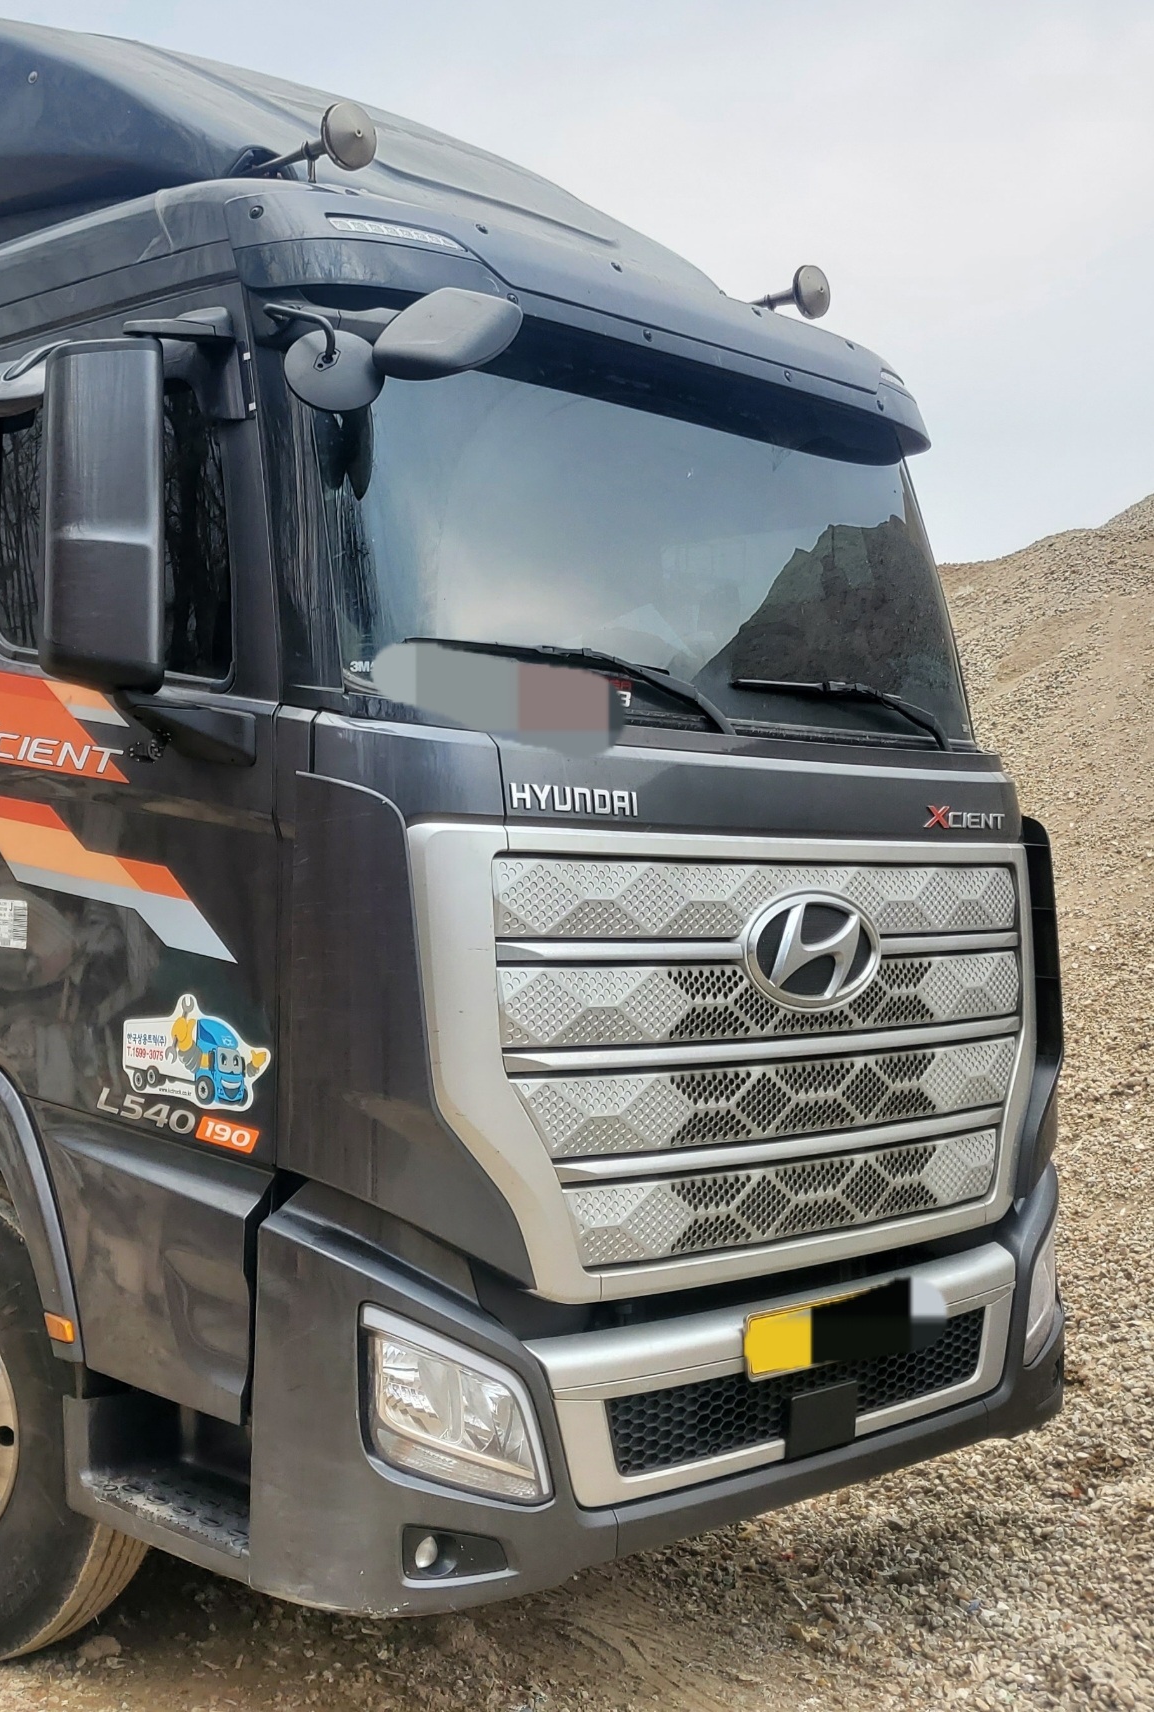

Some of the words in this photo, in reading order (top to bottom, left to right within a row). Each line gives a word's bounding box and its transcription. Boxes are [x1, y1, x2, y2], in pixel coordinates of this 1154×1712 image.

[349, 660, 370, 673] 3M
[509, 782, 638, 817] HYUNDAI
[923, 804, 1006, 830] XCIENT
[127, 1046, 164, 1061] T.1599-3075
[96, 1086, 196, 1135] L540
[204, 1120, 251, 1147] 190
